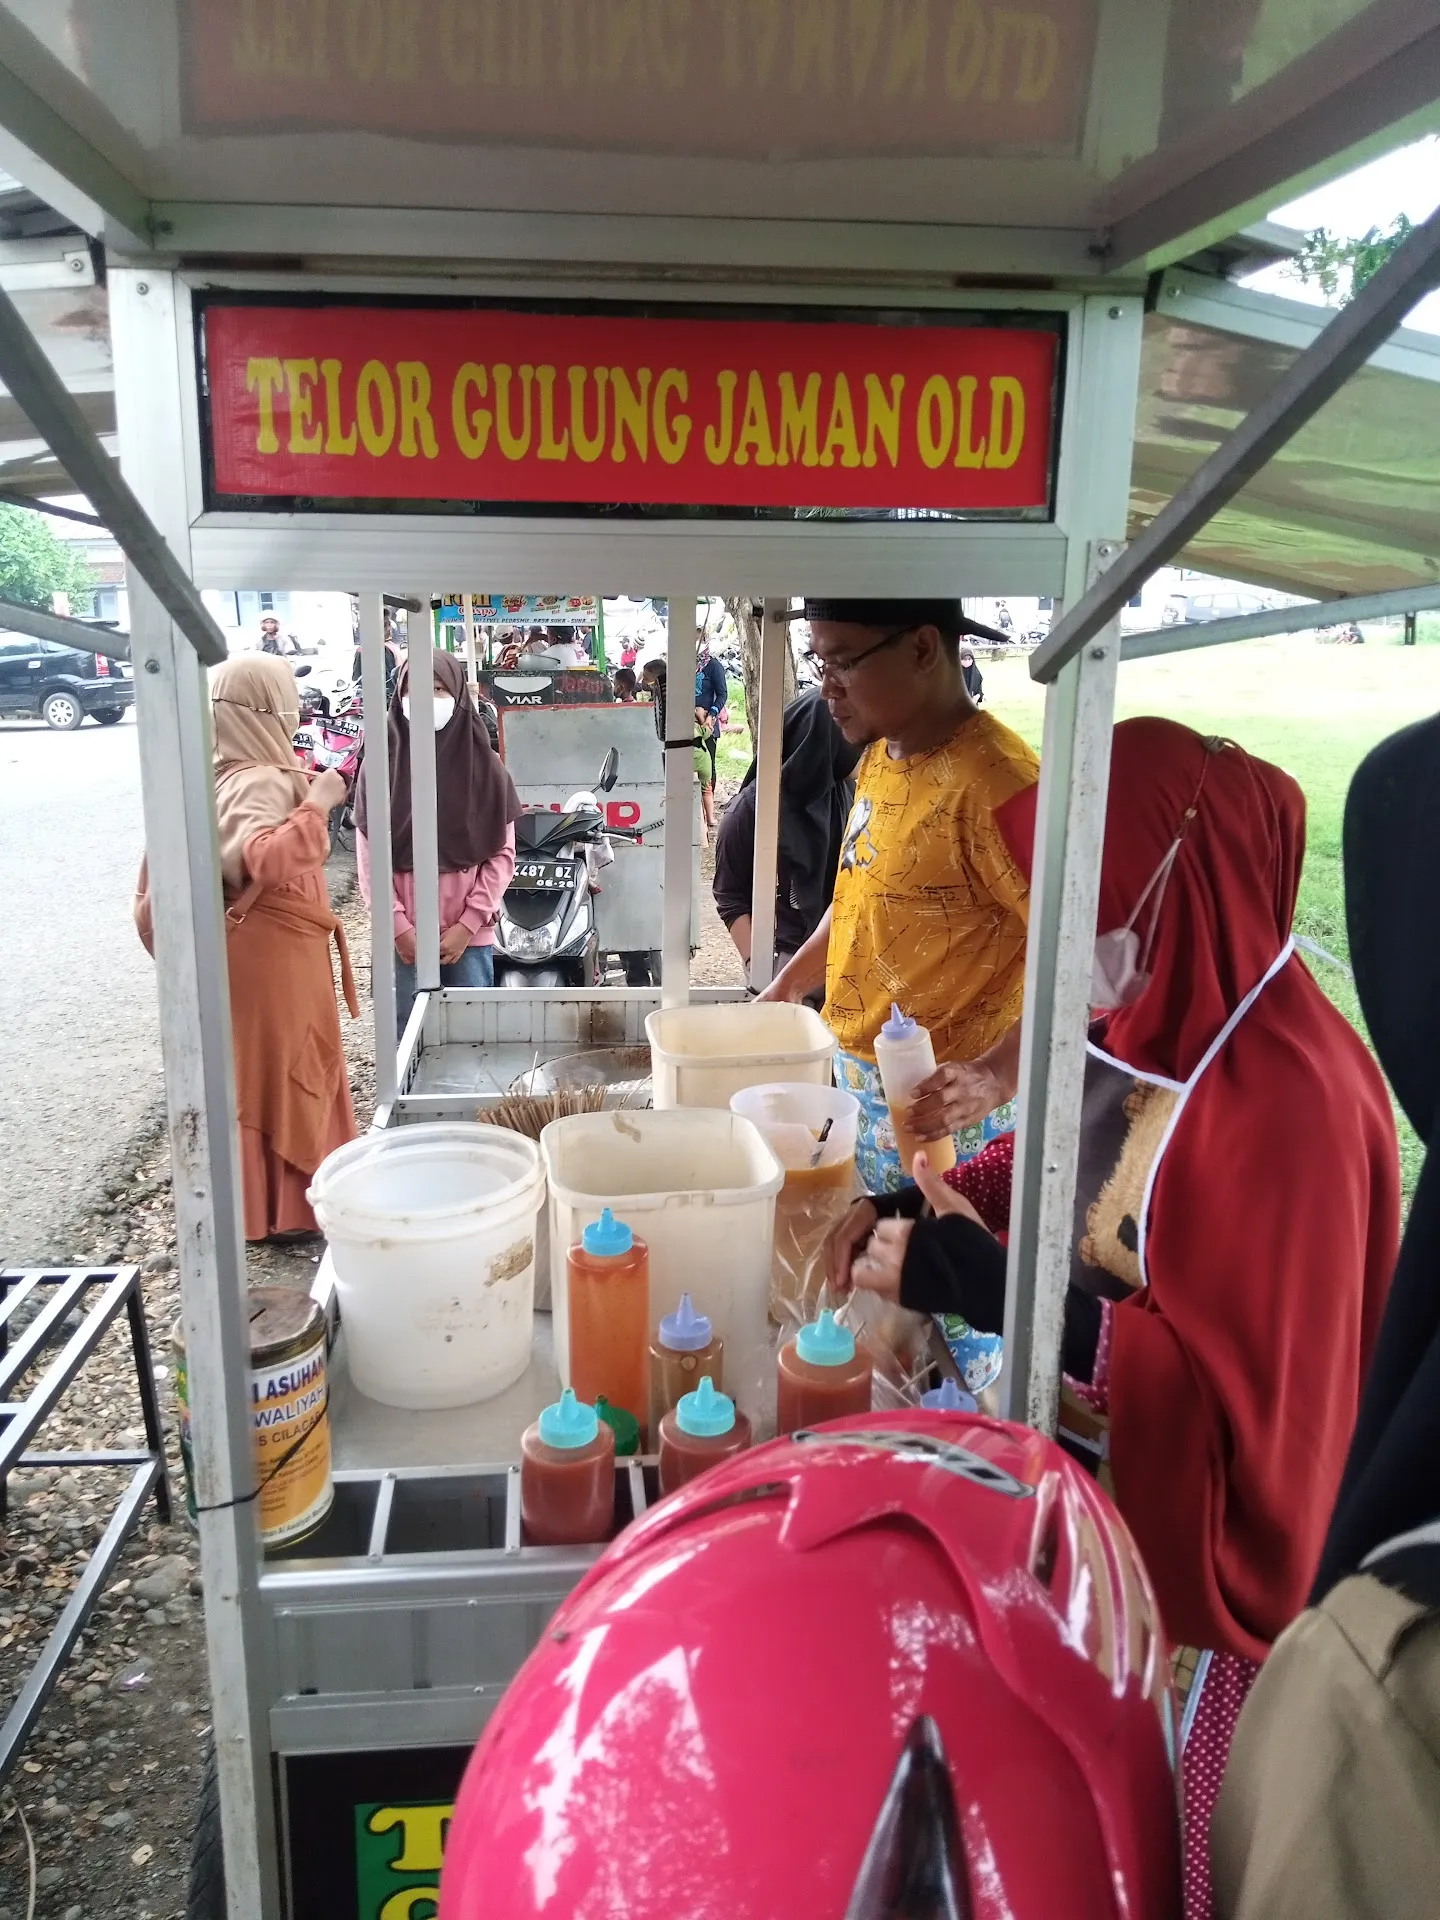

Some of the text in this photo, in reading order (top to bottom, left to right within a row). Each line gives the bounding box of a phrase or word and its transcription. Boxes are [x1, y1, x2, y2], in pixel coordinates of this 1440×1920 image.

[245, 356, 1026, 470] TELOR GULUNG JAMAN OLD
[505, 695, 543, 705] VIAR
